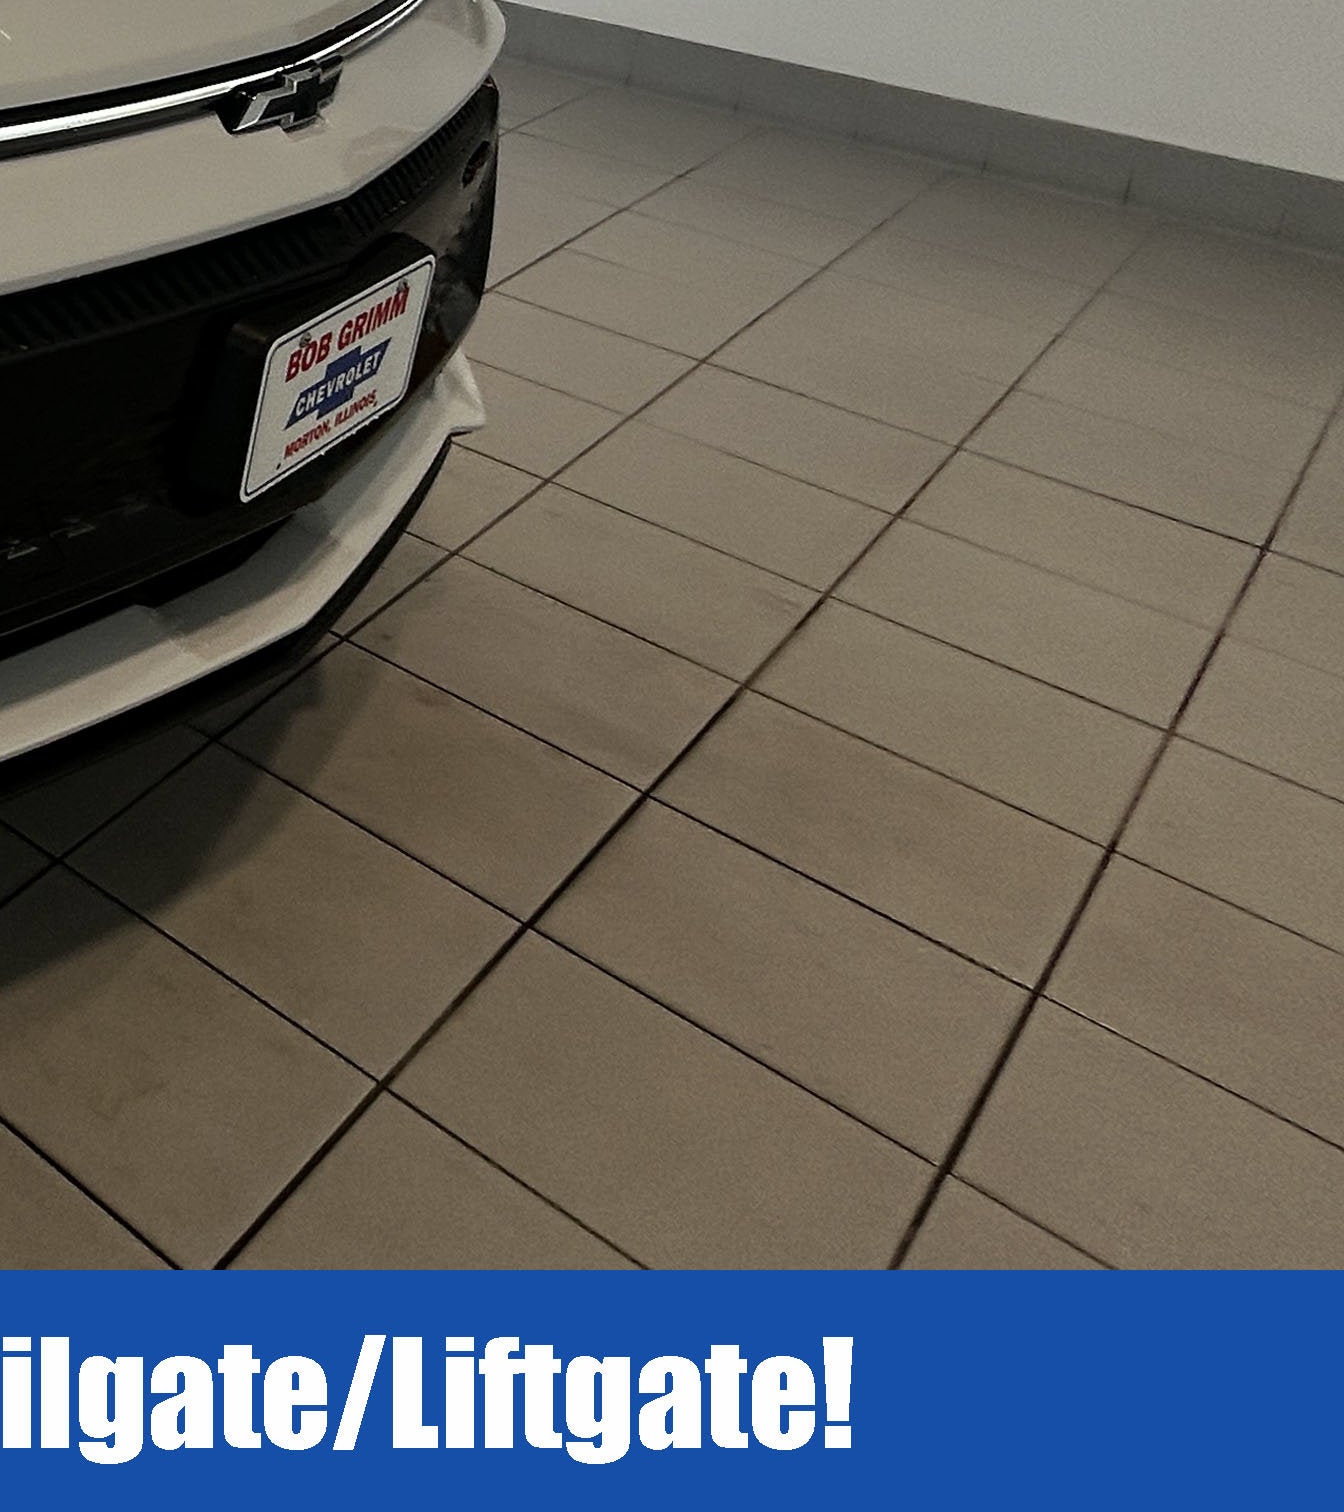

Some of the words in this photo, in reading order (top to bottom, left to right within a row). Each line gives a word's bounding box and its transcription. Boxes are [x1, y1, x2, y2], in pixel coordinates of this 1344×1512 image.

[285, 330, 333, 383] BOB
[337, 286, 411, 353] GRIMM
[295, 351, 381, 417] CHEVROLET
